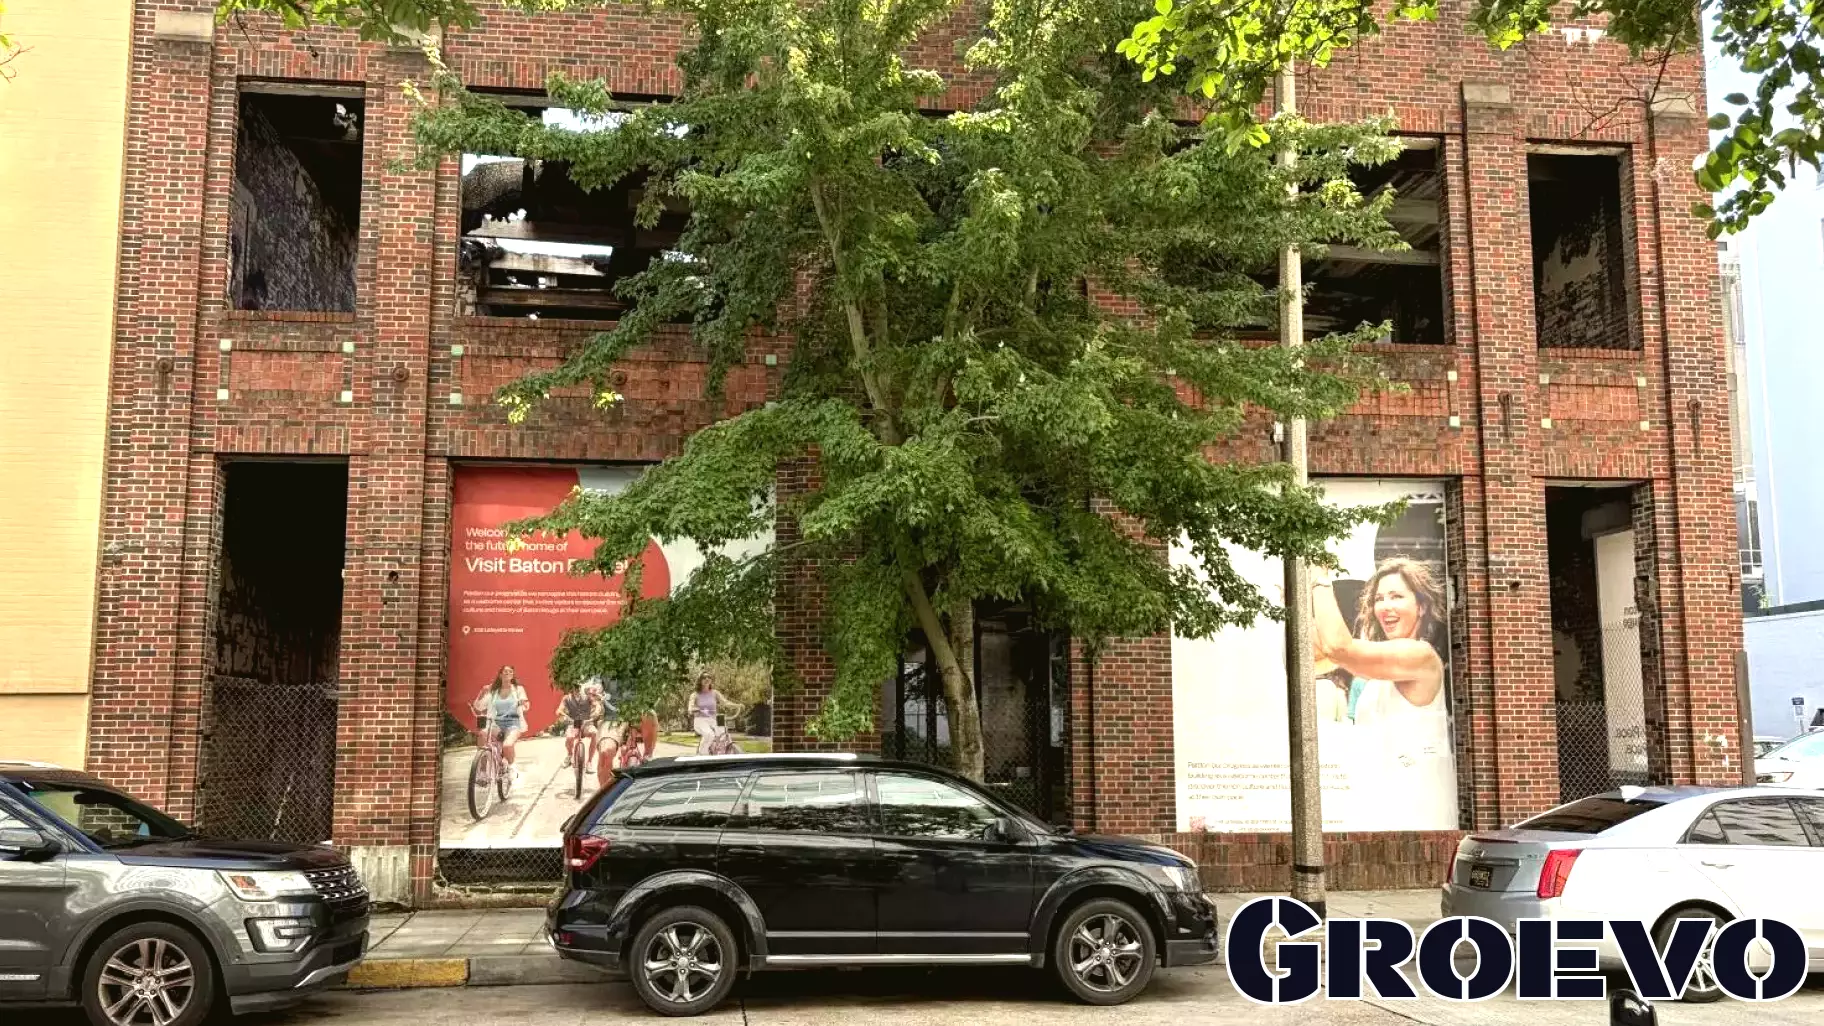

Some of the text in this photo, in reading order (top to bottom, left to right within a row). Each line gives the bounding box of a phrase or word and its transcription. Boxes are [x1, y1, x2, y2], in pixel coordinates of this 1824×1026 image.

[465, 540, 484, 550] the
[556, 540, 568, 550] of
[465, 557, 505, 573] Visit
[509, 557, 564, 573] Baton
